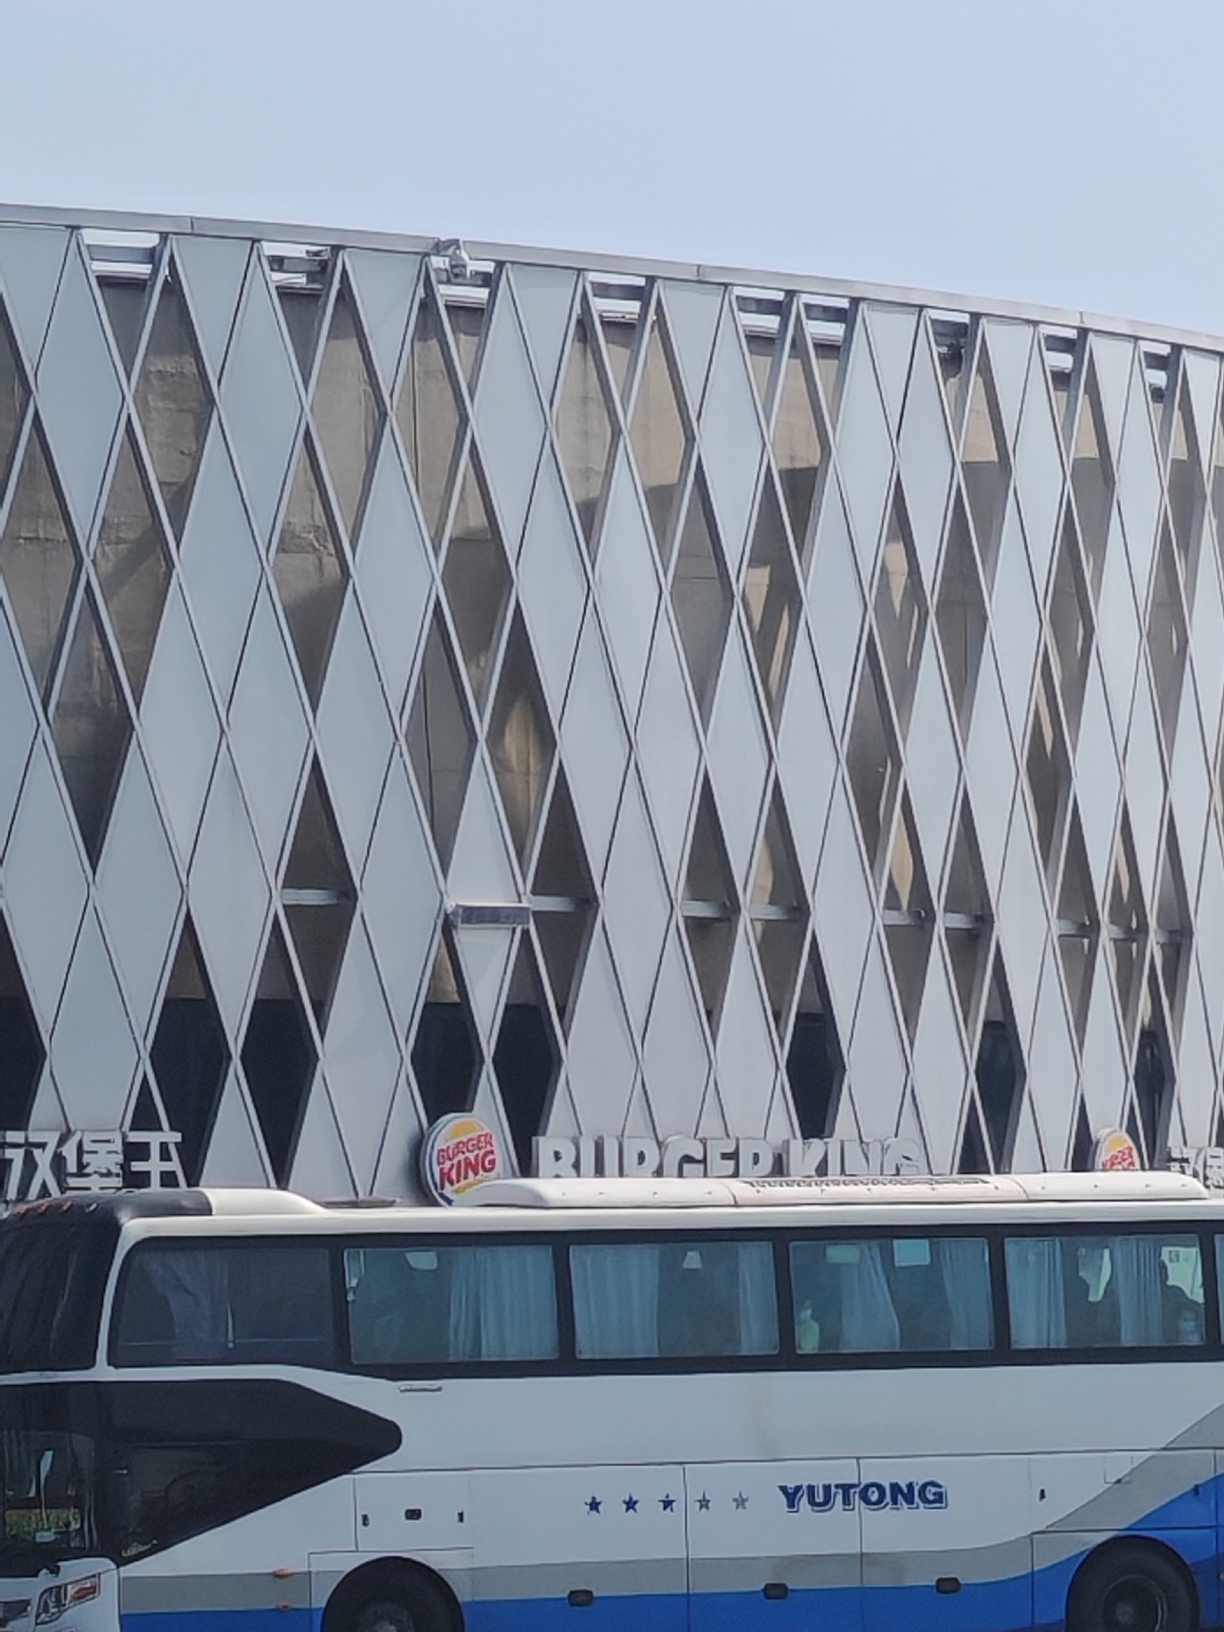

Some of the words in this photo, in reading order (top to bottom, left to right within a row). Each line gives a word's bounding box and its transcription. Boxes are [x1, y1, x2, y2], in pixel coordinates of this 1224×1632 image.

[3, 1131, 183, 1199] 汉堡王
[437, 1132, 494, 1167] BURGER
[440, 1149, 496, 1192] KING
[777, 1480, 948, 1513] YUTONG
